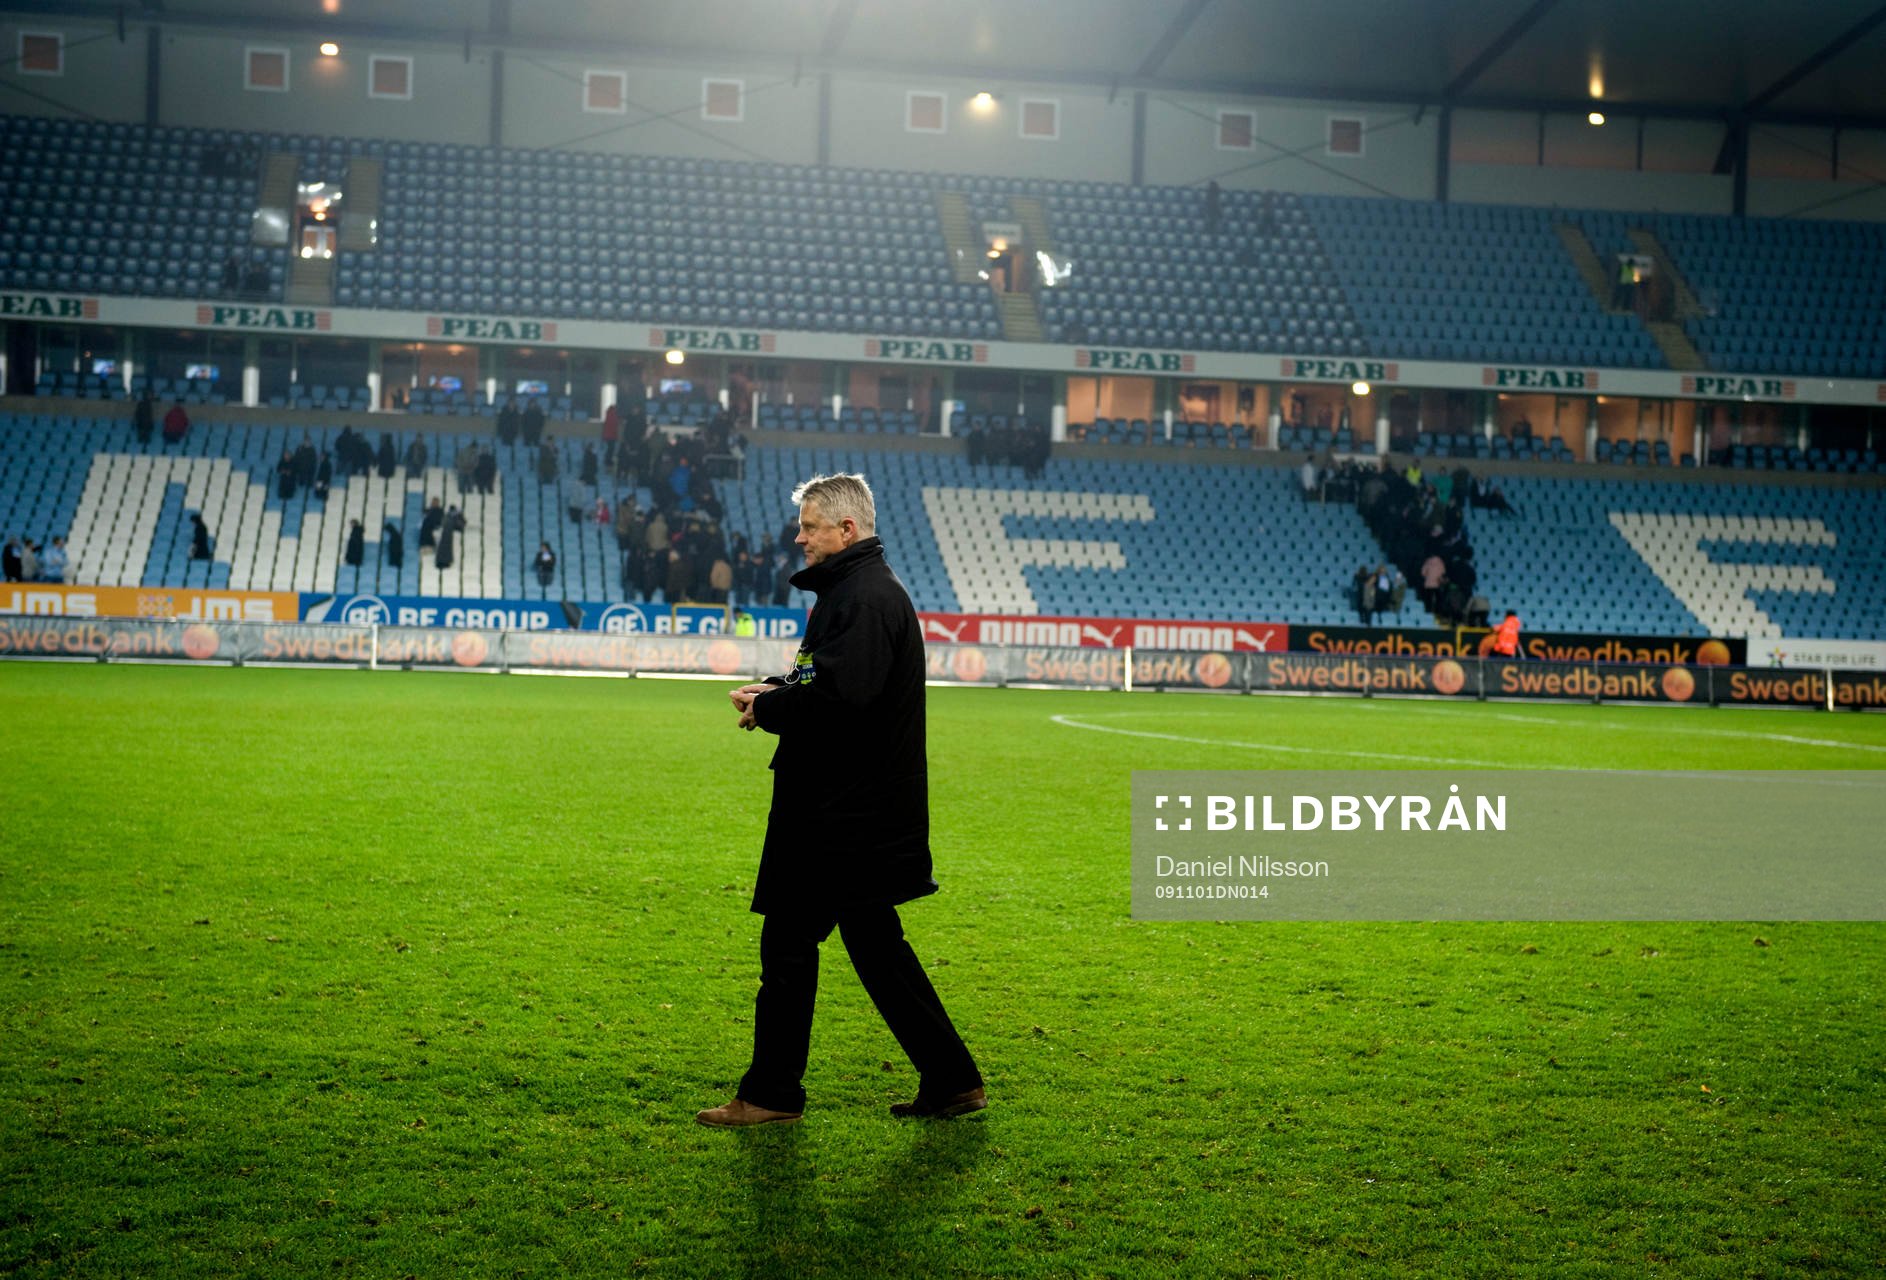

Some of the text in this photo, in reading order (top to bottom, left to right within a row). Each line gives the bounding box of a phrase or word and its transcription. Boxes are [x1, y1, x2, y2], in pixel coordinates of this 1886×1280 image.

[0, 295, 83, 317] EAB
[212, 306, 315, 330] PEAB
[442, 317, 542, 340] PEAB
[664, 329, 760, 351] PEAB
[879, 339, 974, 362] PEAB
[1089, 350, 1182, 372] PEAB
[1294, 360, 1385, 381] PEAB
[1495, 368, 1585, 389] PEAB
[1694, 376, 1783, 397] PEAB
[445, 608, 550, 632] GROUP
[1308, 632, 1472, 658] Swedbank
[1528, 639, 1692, 664] Swedbank
[1025, 652, 1193, 683] Swedbank
[1268, 659, 1426, 688] Swedbank
[1501, 666, 1657, 697] Swedbank
